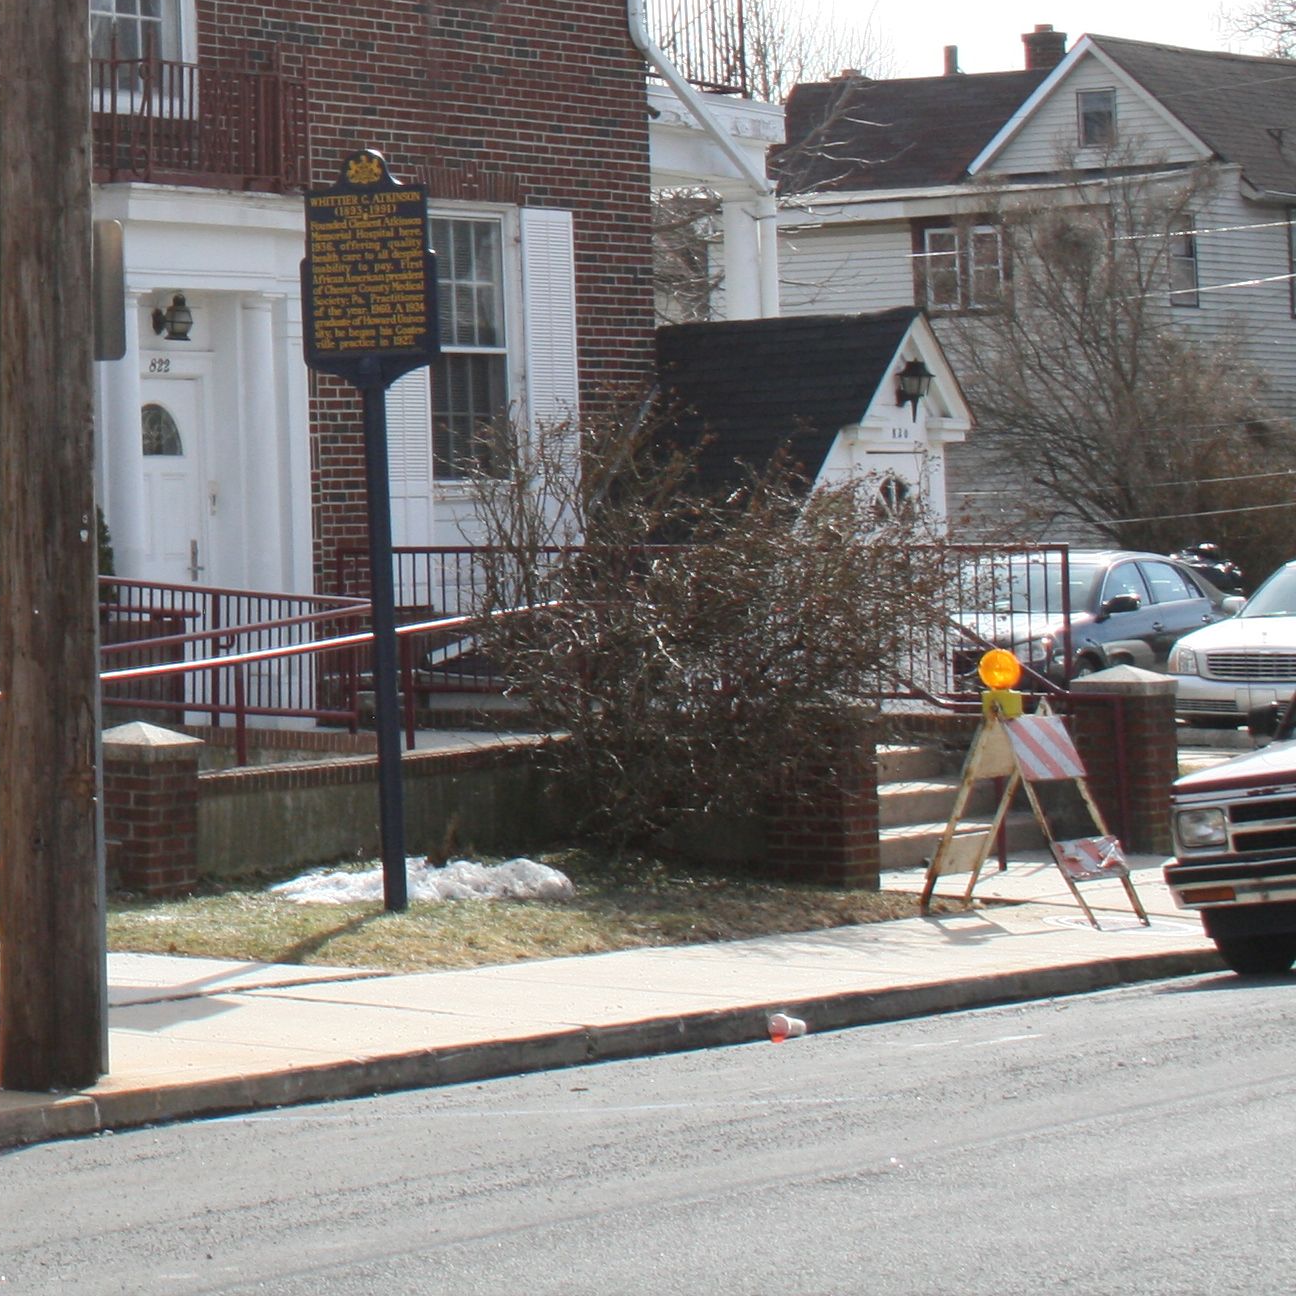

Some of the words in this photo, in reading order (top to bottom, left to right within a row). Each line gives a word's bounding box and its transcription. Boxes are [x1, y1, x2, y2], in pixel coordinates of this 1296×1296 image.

[310, 195, 358, 207] WHITTIER
[372, 192, 420, 204] ATKINSON
[310, 219, 347, 230] Founded
[384, 216, 422, 227] Atkinson
[311, 231, 352, 242] Memorial
[356, 229, 393, 240] Hospital
[340, 240, 381, 252] offering
[387, 237, 422, 250] quality
[365, 252, 374, 260] to
[359, 262, 368, 271] to
[400, 259, 424, 269] First
[312, 273, 345, 284] African
[345, 272, 384, 282] American
[385, 270, 424, 283] president
[313, 285, 324, 296] of
[325, 284, 357, 295] Chester
[359, 283, 389, 295] County
[391, 280, 424, 291] Medical
[370, 292, 424, 303] Practitioner
[314, 307, 324, 317] of
[328, 306, 342, 316] the
[395, 303, 403, 312] A
[352, 315, 363, 325] of
[363, 314, 396, 324] Howard
[349, 327, 376, 339] began
[379, 325, 393, 335] his
[339, 338, 375, 351] practice
[379, 336, 389, 346] in
[149, 358, 170, 373] 822
